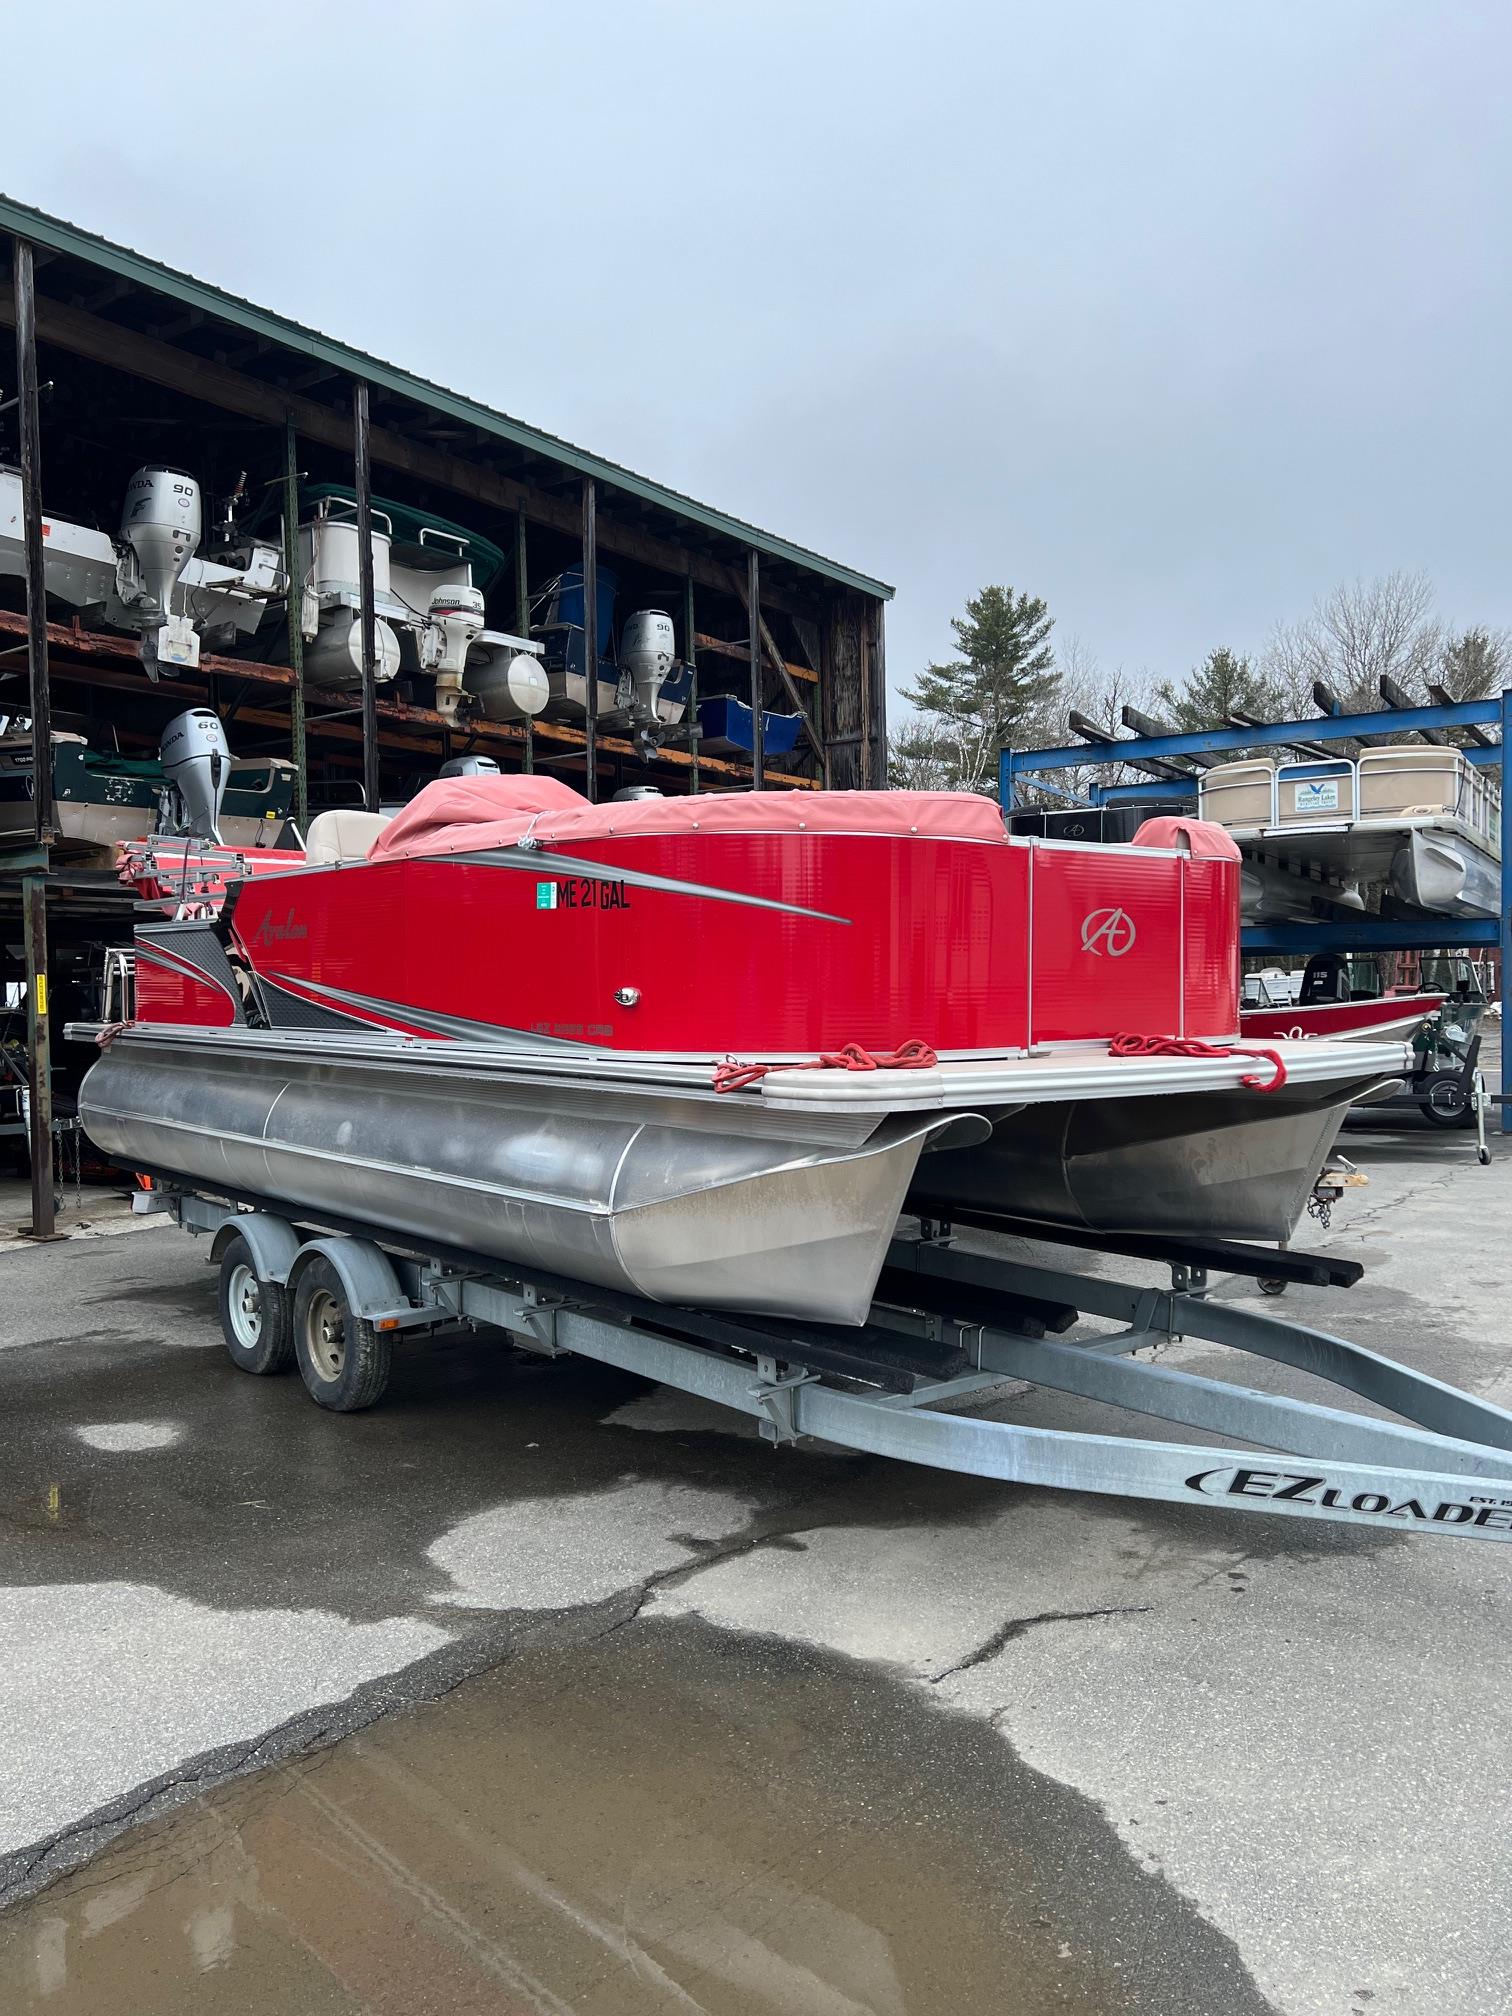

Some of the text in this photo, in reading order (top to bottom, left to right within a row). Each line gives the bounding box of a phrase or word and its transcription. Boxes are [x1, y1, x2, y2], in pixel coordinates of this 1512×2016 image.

[173, 484, 193, 496] 90
[198, 721, 219, 729] 60
[556, 880, 577, 908] ME
[581, 879, 597, 907] 21
[600, 880, 630, 910] GAL
[1469, 1496, 1497, 1504] EST.
